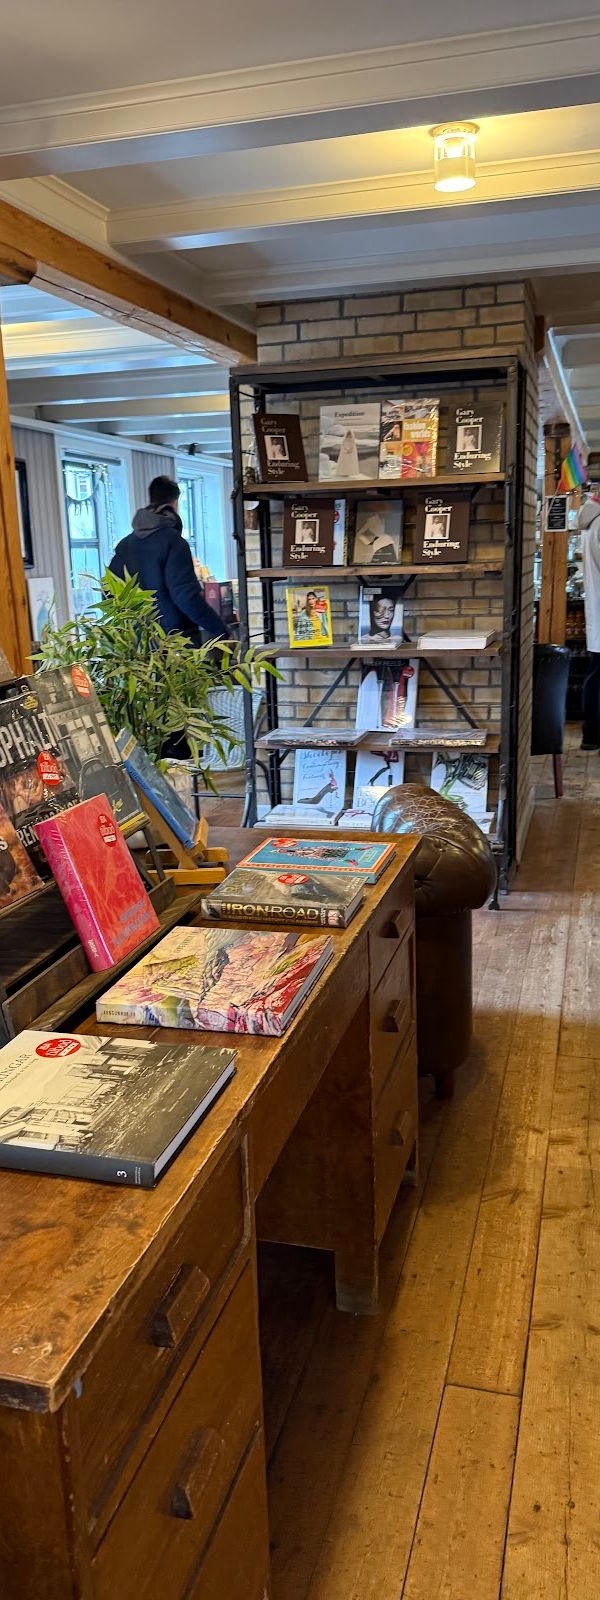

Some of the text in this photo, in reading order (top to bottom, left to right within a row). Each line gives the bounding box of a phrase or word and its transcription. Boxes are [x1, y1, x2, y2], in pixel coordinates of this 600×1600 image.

[456, 408, 474, 418] Gary
[456, 415, 484, 425] Cooper
[261, 425, 287, 436] Cooper
[453, 450, 492, 462] Enduring
[267, 459, 301, 472] Enduring
[453, 459, 474, 470] Style
[267, 467, 286, 477] Style
[425, 497, 443, 507] Gary
[291, 503, 309, 514] Gary
[424, 504, 453, 514] Cooper
[291, 510, 318, 521] Cooper
[290, 543, 326, 554] Enduring
[423, 539, 460, 550] Enduring
[289, 552, 309, 563] Style
[421, 548, 442, 559] Style
[226, 903, 270, 916] IRON
[271, 906, 319, 920] ROAD
[117, 1170, 127, 1178] 3
